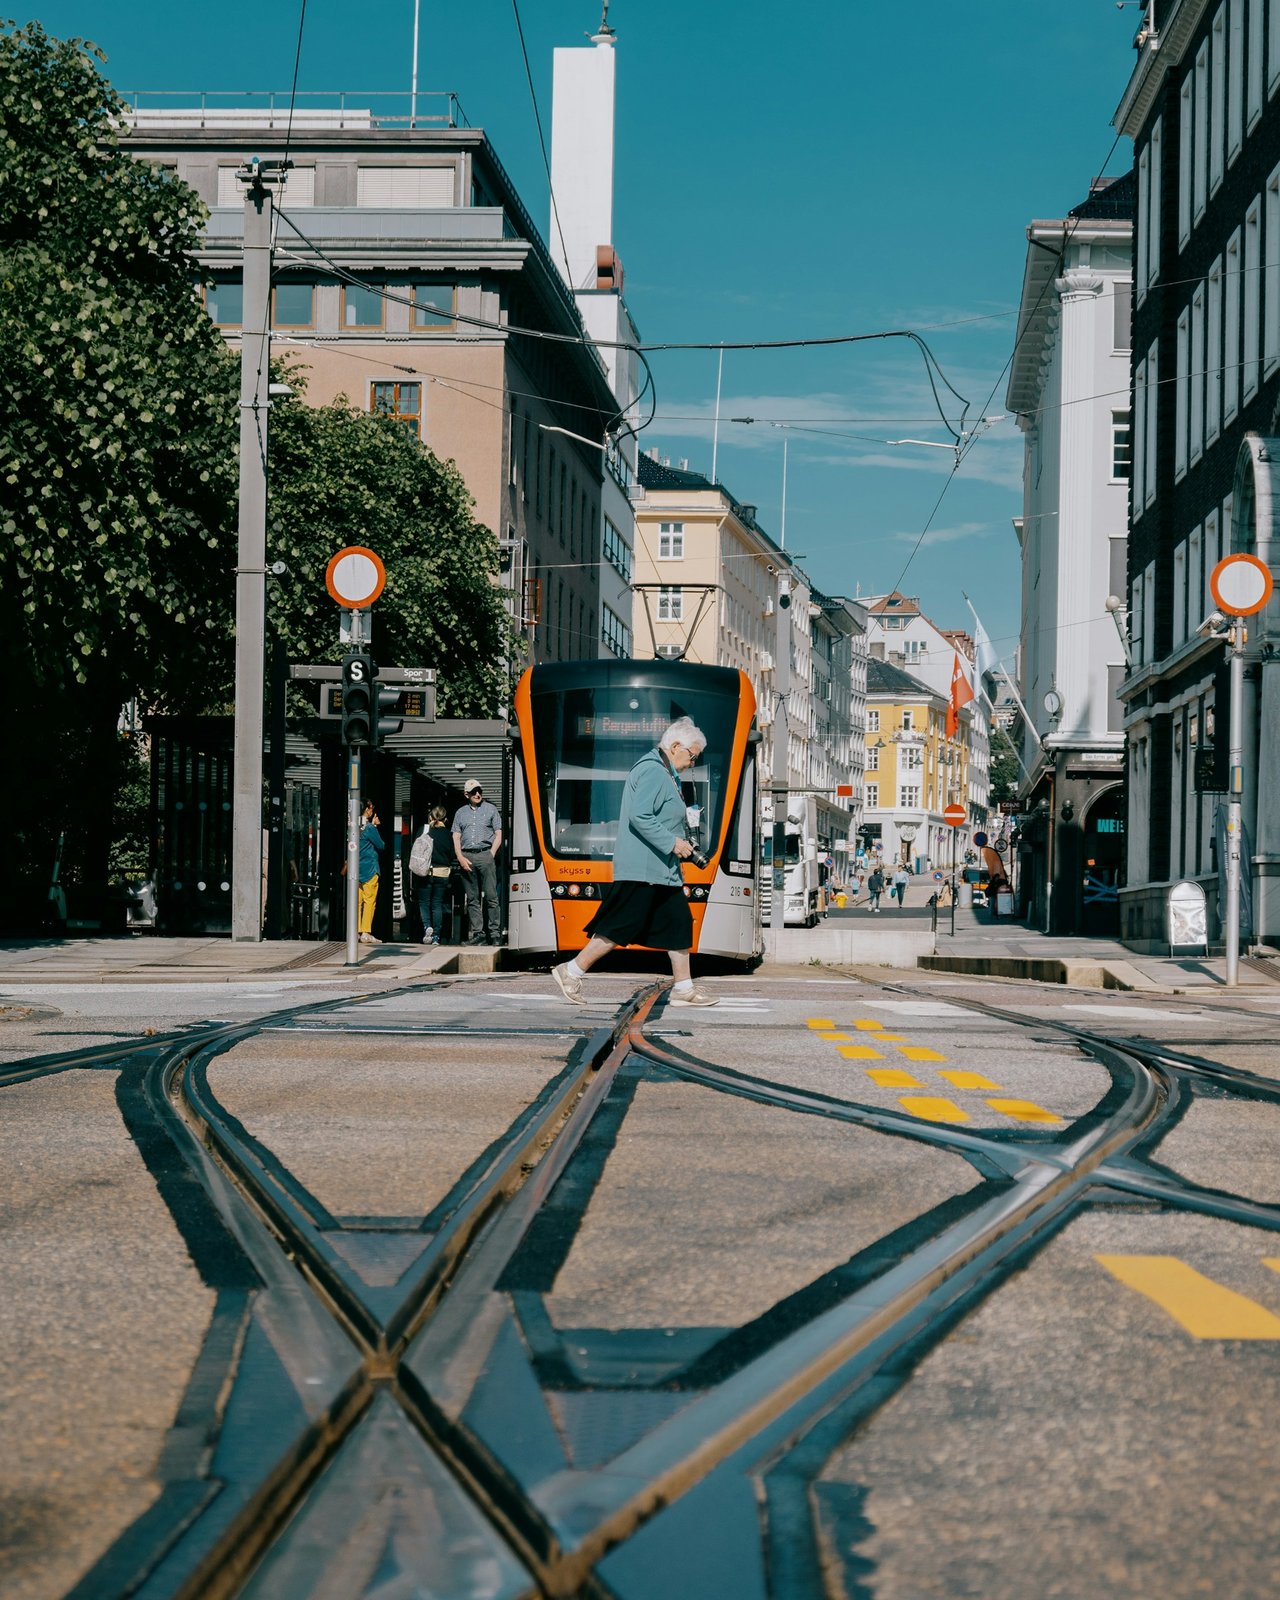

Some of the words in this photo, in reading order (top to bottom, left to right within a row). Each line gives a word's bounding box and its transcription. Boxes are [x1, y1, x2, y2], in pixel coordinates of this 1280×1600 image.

[350, 661, 363, 681] S
[403, 669, 423, 677] Spor
[425, 669, 434, 682] 1
[602, 716, 641, 734] Bergen
[559, 866, 584, 877] skyss
[520, 882, 530, 894] 216
[731, 885, 741, 897] 216
